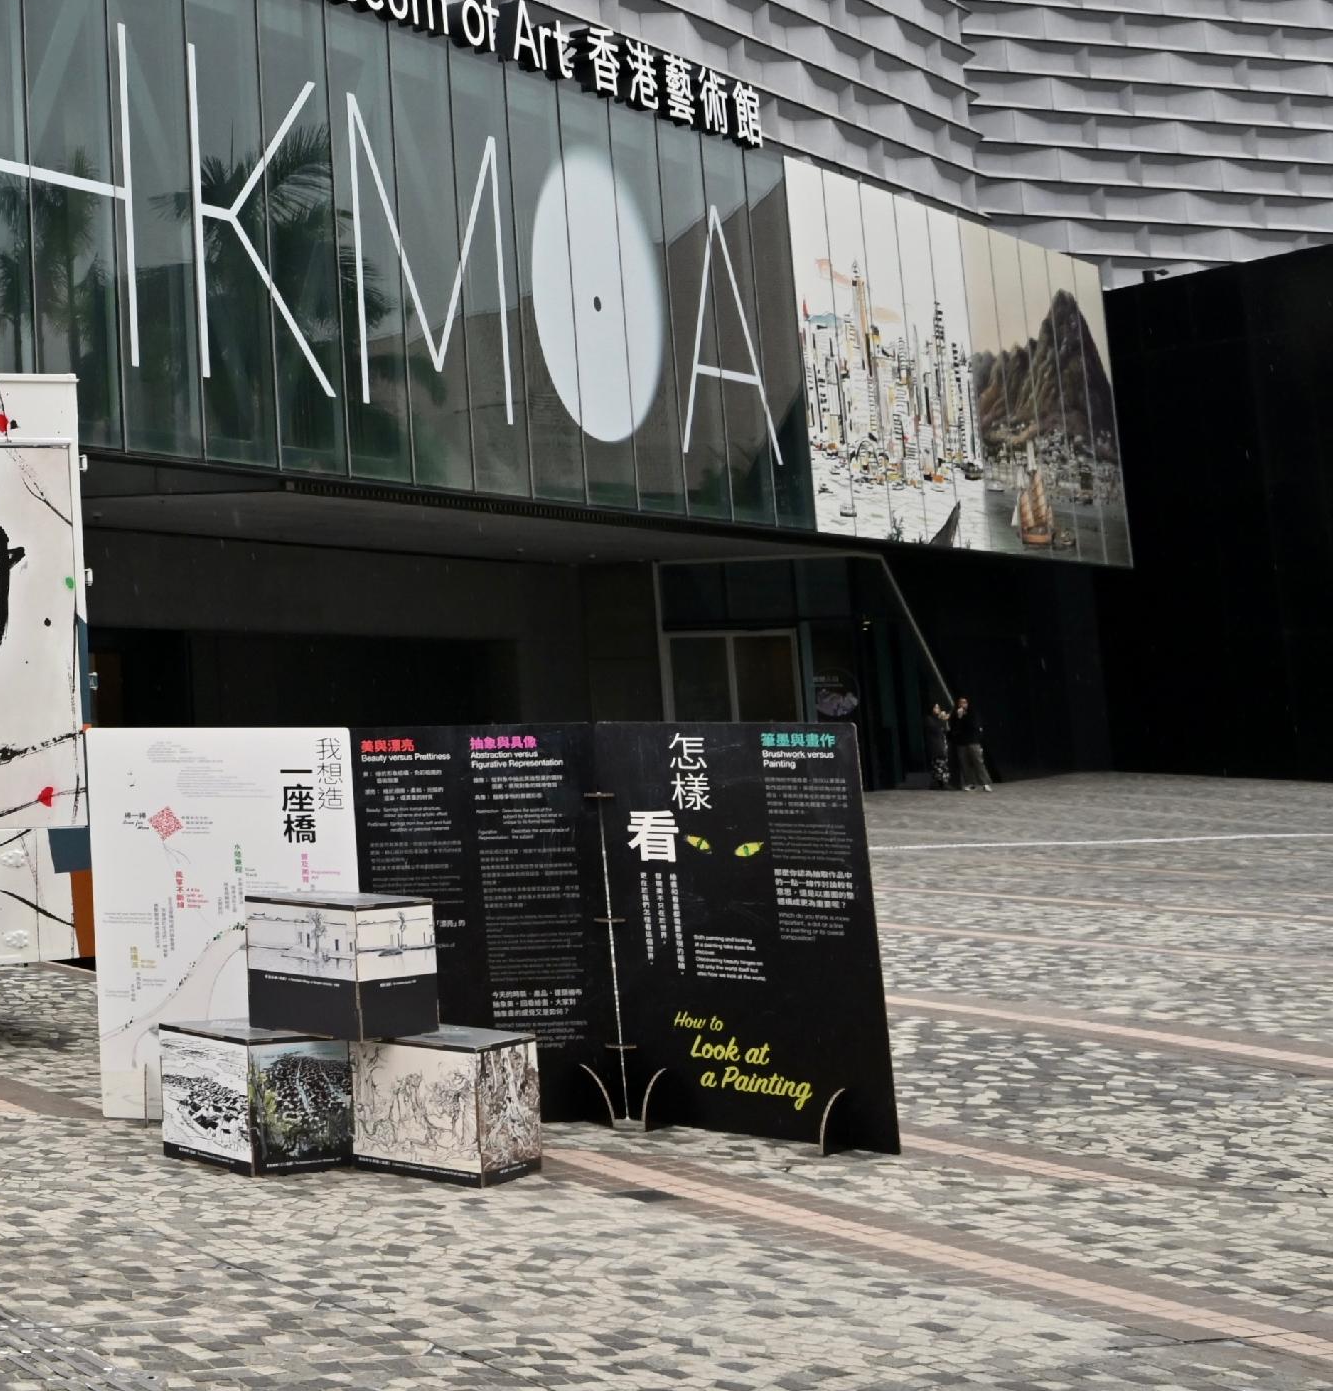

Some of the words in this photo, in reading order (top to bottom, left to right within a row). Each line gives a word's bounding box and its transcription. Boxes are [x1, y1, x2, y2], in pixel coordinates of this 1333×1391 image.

[513, 9, 574, 80] Art
[587, 28, 765, 149] 香港藝術館
[361, 739, 415, 753] 美與漂亮
[361, 754, 387, 763] Beauty
[415, 752, 451, 761] Prettiness
[471, 751, 512, 759] Abstraction
[762, 750, 805, 758] Brushwork
[315, 737, 344, 810] 我想造
[471, 760, 507, 769] Figurative
[509, 759, 563, 768] Representation
[668, 733, 712, 811] 怎樣
[763, 760, 796, 769] Painting
[280, 769, 317, 844] 一座橋
[627, 810, 679, 863] 看
[674, 1011, 706, 1029] How
[709, 1015, 724, 1032] to
[690, 1034, 740, 1061] Look
[744, 1042, 770, 1065] at
[700, 1071, 718, 1088] a
[721, 1066, 813, 1111] Painting
